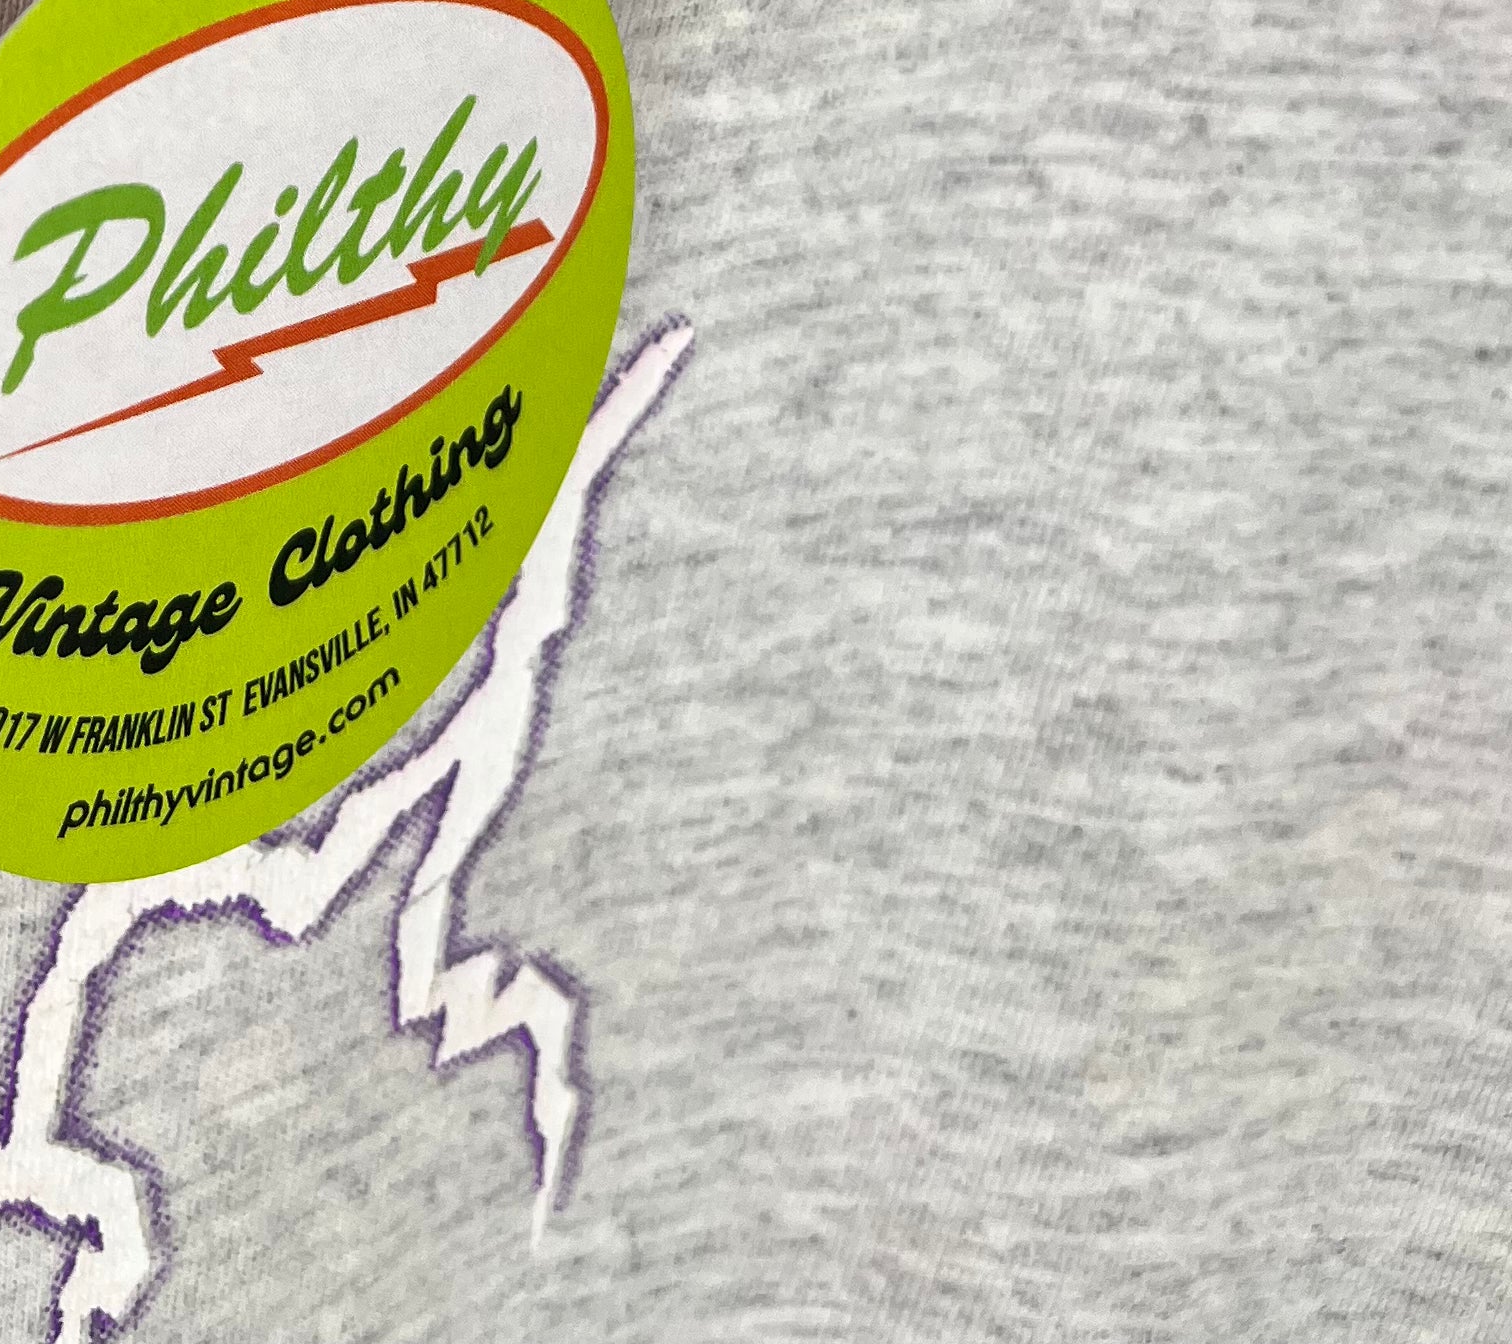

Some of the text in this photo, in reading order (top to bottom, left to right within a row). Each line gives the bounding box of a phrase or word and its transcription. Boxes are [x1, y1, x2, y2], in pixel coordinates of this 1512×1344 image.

[1, 94, 542, 395] Philthy
[268, 384, 523, 608] Clothing
[39, 715, 69, 755] W
[67, 702, 197, 755] FRANKLIN
[198, 689, 234, 735] ST
[242, 608, 391, 718] EVANSVILLE,
[392, 576, 419, 621] IN
[421, 505, 496, 596] 47712
[57, 665, 402, 839] philthyvintage.com
